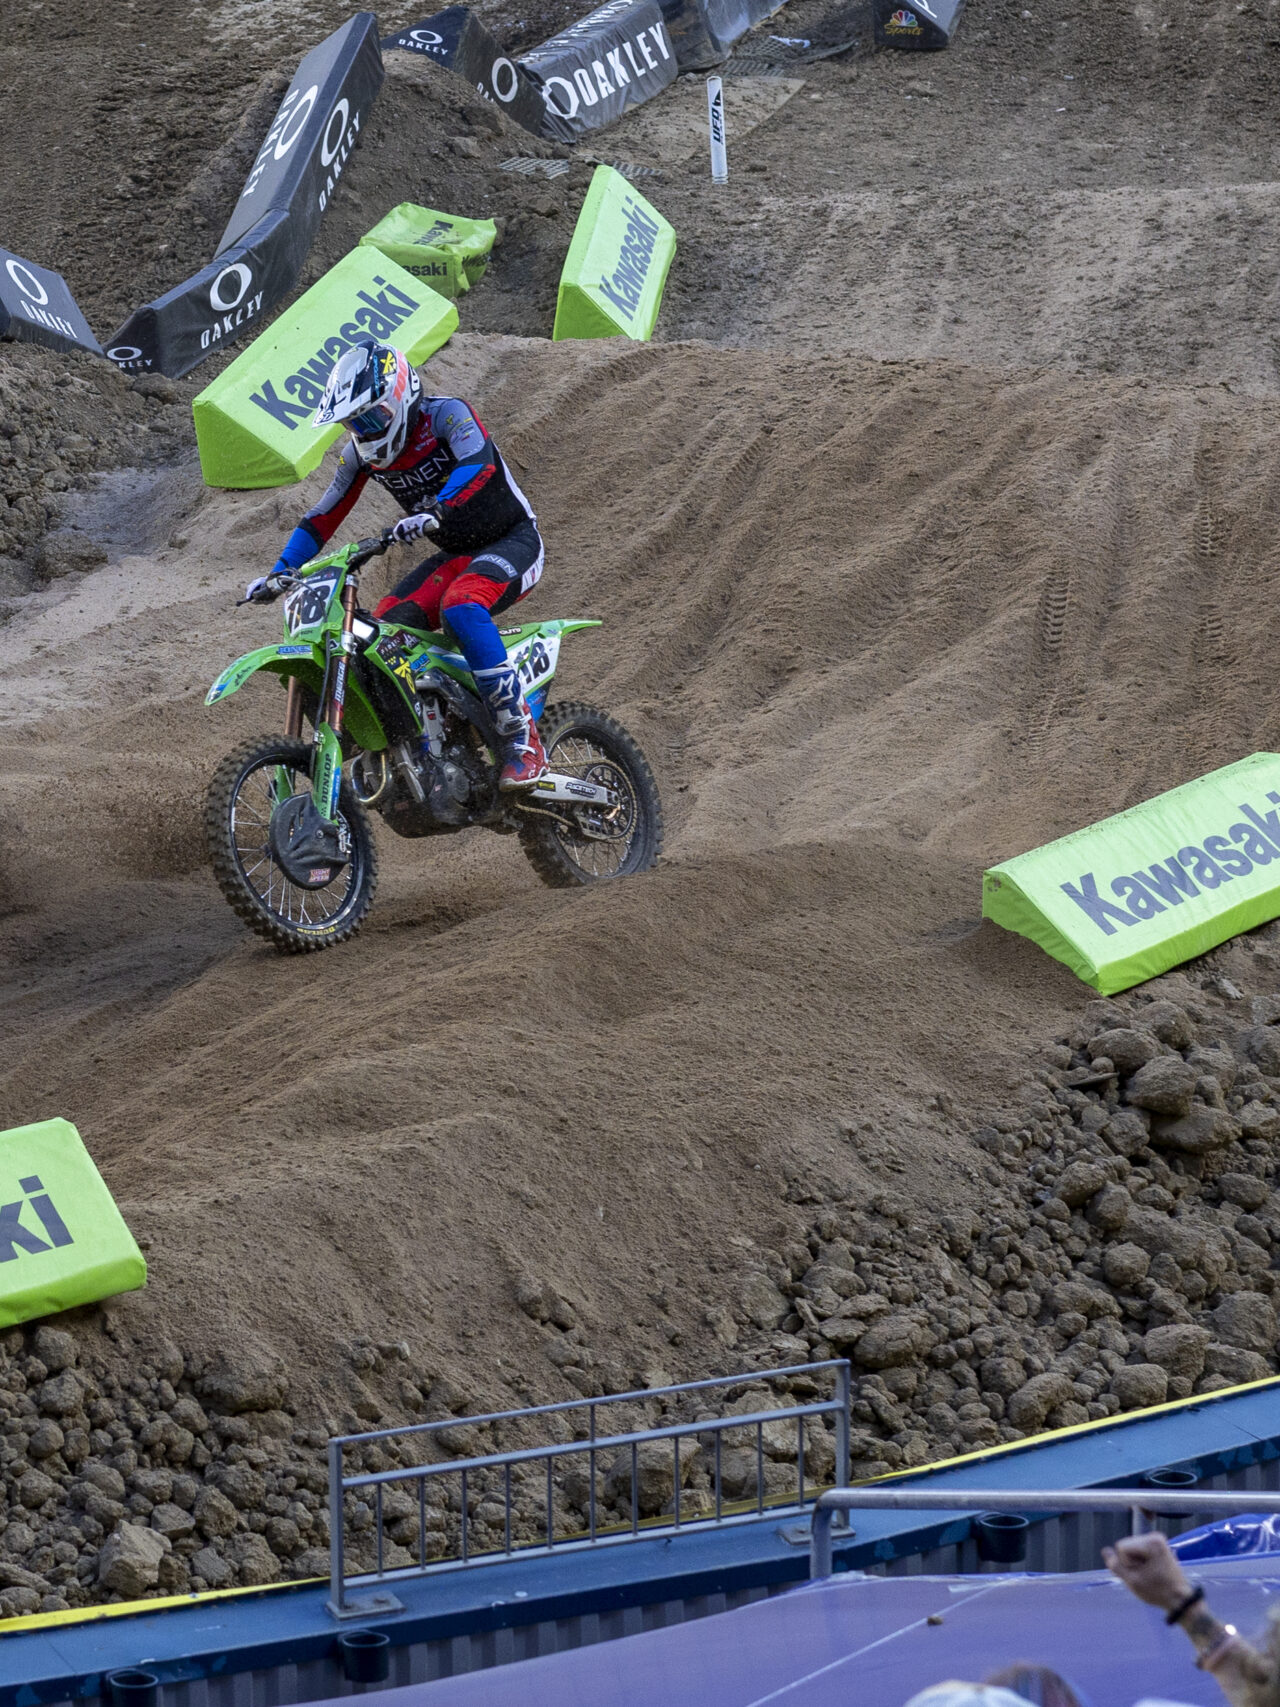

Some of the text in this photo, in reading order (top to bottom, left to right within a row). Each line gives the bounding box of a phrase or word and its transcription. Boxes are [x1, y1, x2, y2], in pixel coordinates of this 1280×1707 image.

[398, 38, 449, 56] OAKLEY
[573, 21, 670, 107] OAKLEY
[242, 88, 300, 198] OAKLEY
[711, 108, 721, 144] UFO
[318, 111, 359, 212] OAKLEY
[401, 262, 447, 276] asaki
[598, 195, 660, 322] Kawasaki
[20, 300, 78, 339] OAKLEY
[200, 291, 264, 349] OAKLEY
[118, 359, 153, 368] KLEY
[321, 753, 332, 803] DUNLOP
[1060, 791, 1280, 936] Kawasak
